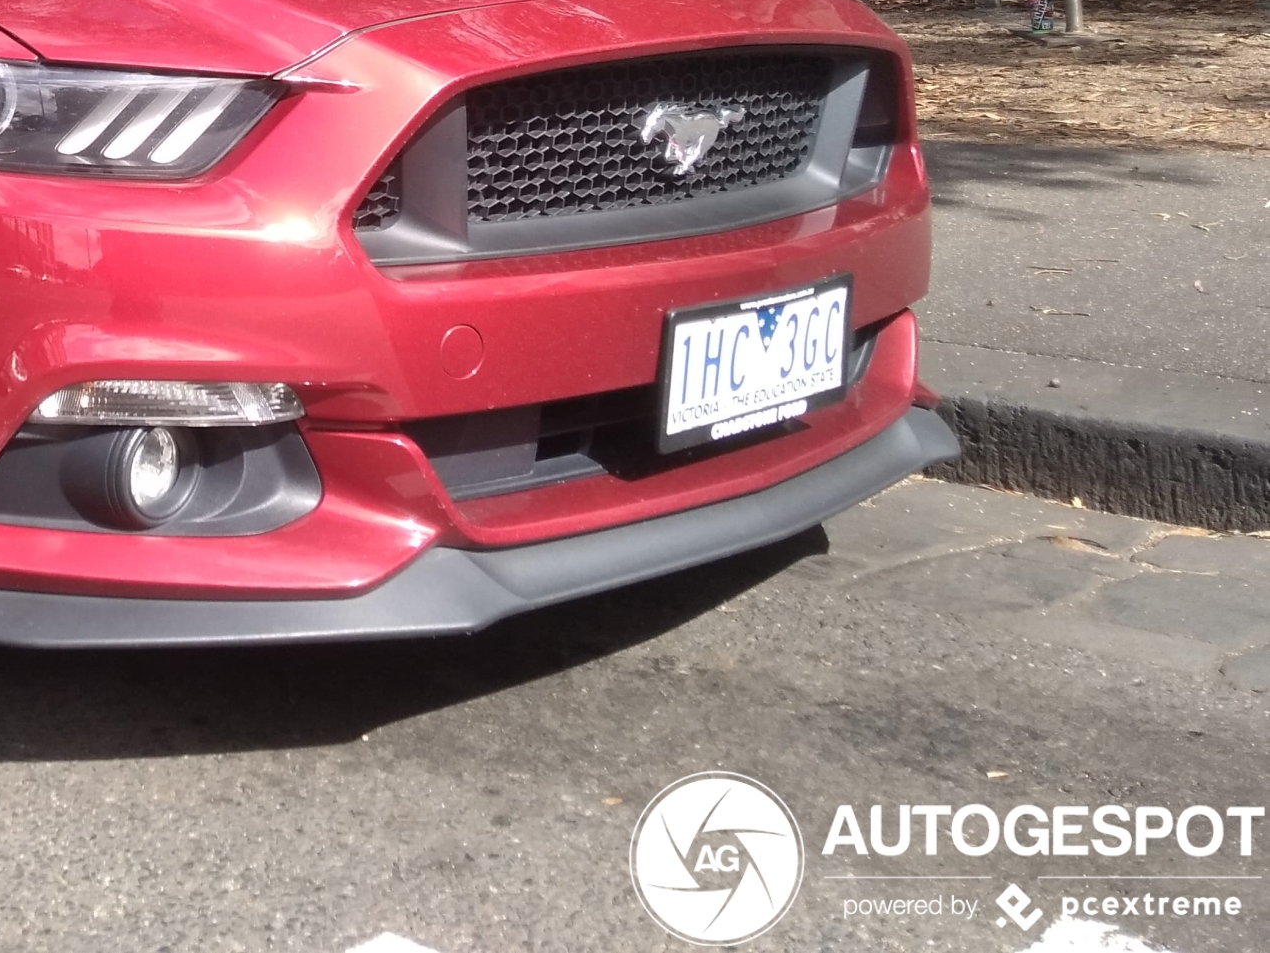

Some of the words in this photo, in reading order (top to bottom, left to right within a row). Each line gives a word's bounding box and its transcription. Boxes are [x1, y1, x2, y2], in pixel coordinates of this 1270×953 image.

[671, 401, 720, 425] VICTORIA
[732, 393, 751, 406] THE
[753, 378, 808, 404] EDUCATION
